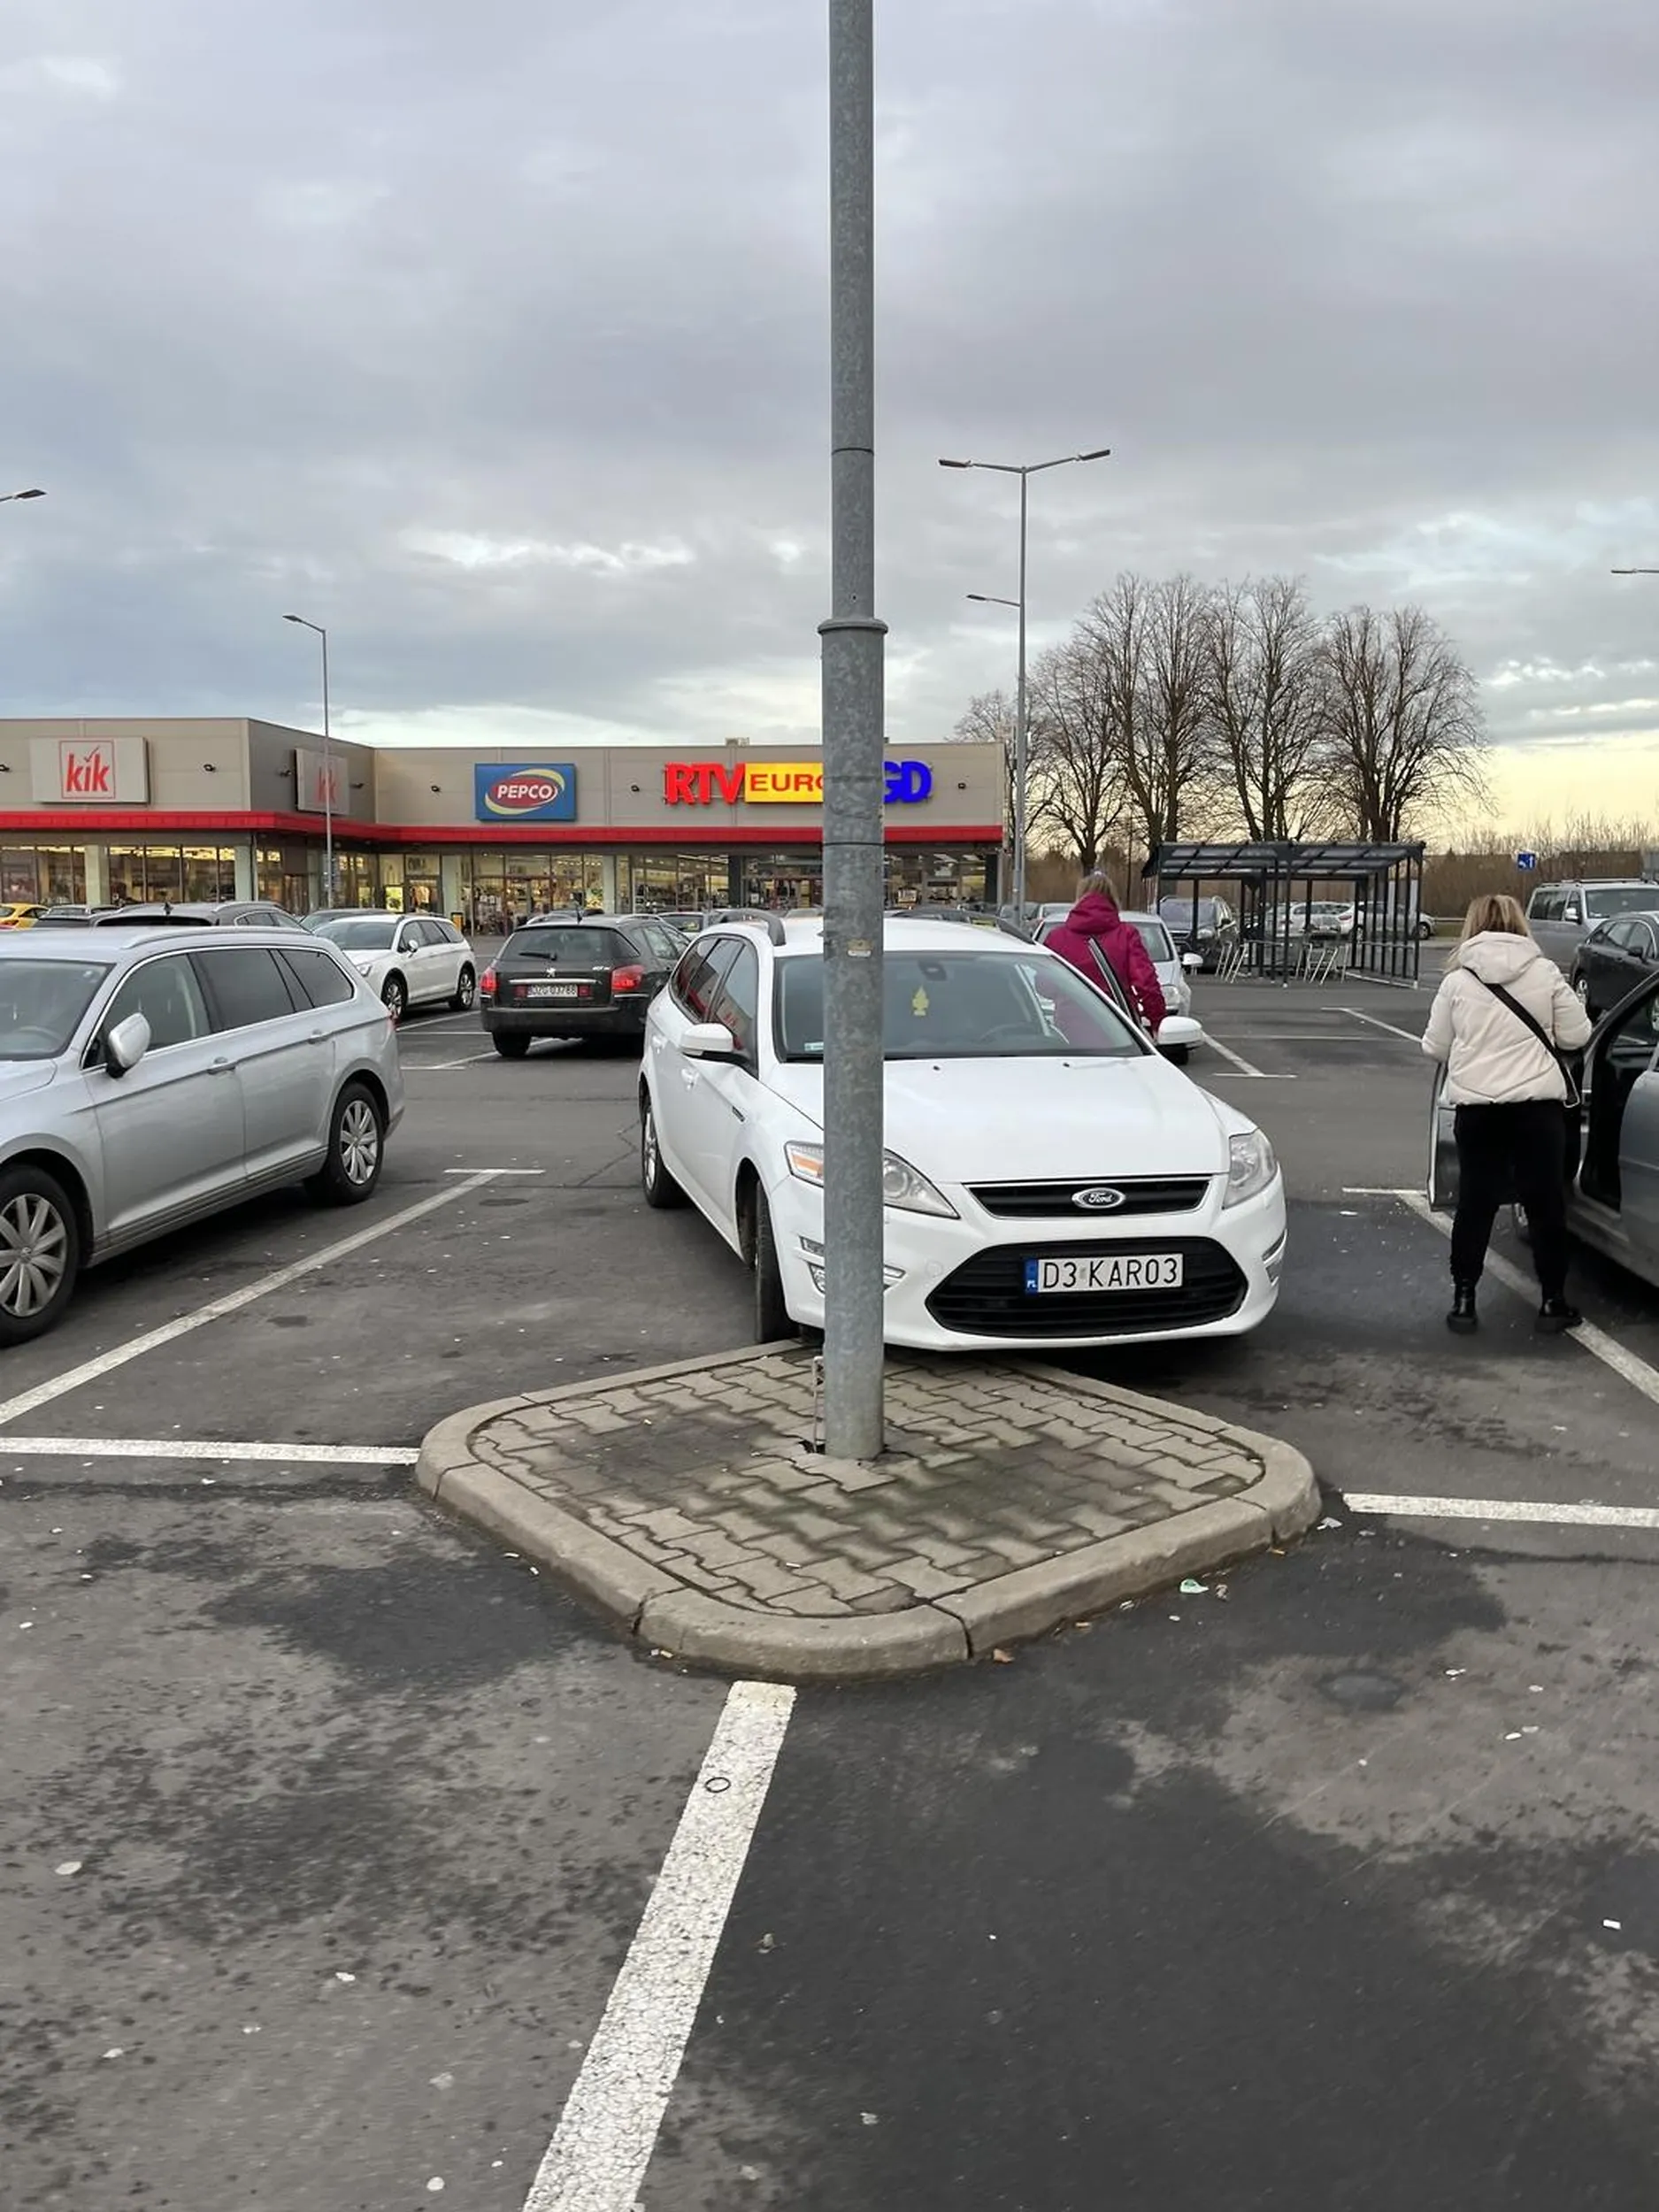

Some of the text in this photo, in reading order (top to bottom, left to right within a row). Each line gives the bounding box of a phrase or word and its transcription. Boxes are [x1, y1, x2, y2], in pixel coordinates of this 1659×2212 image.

[497, 784, 554, 799] PEPCO
[665, 761, 745, 805] RTV
[882, 761, 933, 804] GD
[1087, 1192, 1113, 1204] Ford
[1042, 1262, 1078, 1289] D3
